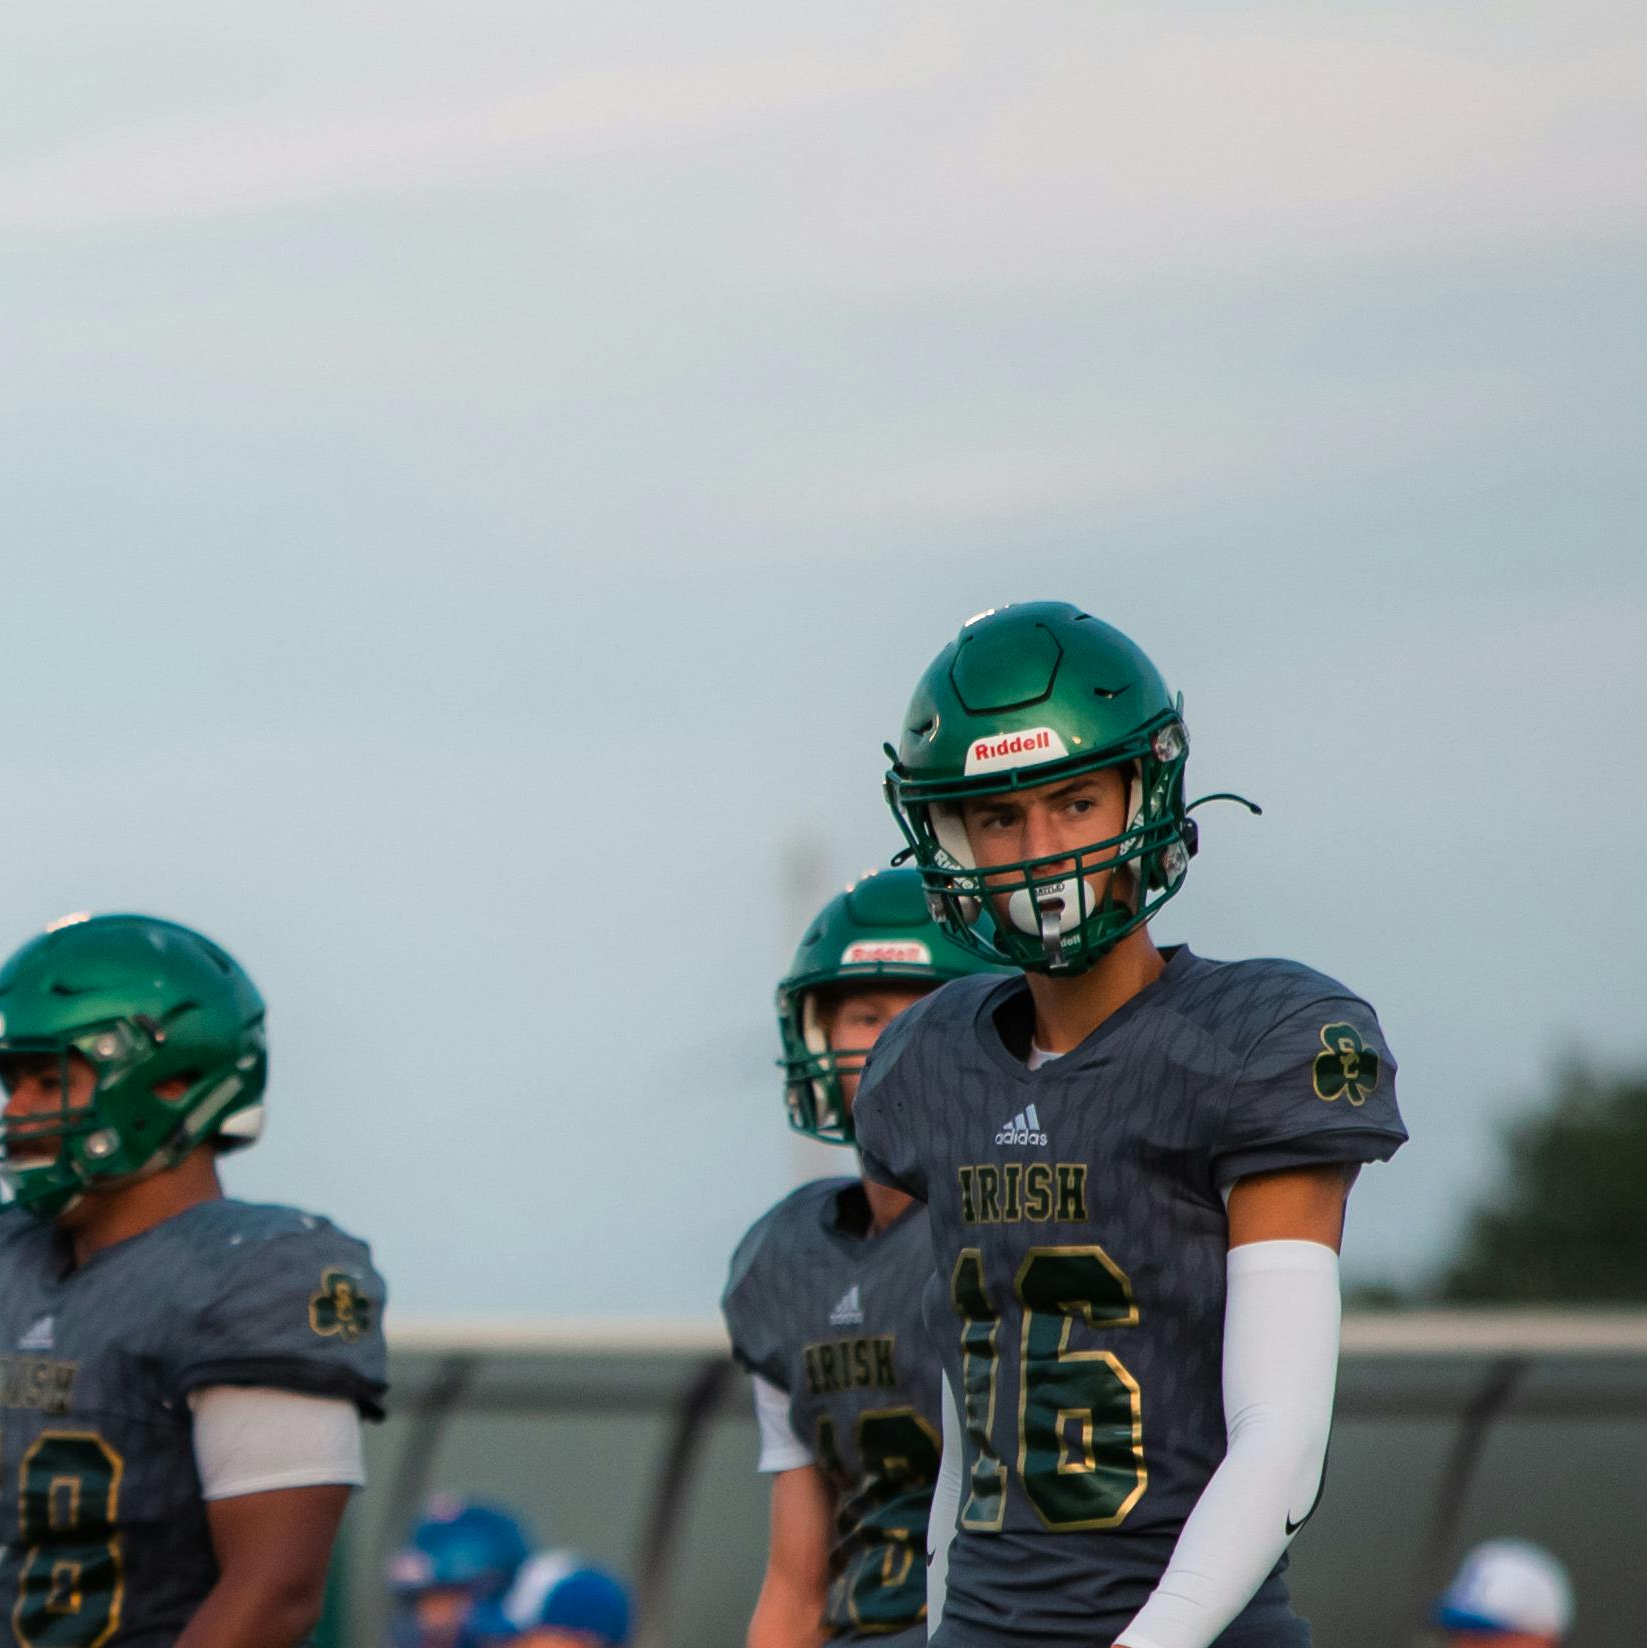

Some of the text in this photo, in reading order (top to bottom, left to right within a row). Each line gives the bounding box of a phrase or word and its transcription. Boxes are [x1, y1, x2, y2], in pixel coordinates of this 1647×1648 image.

[974, 732, 1051, 761] Riddell
[994, 1127, 1049, 1147] adidas
[957, 1162, 1090, 1225] IRISH
[803, 1334, 896, 1395] IRISH
[950, 1244, 1149, 1533] 16
